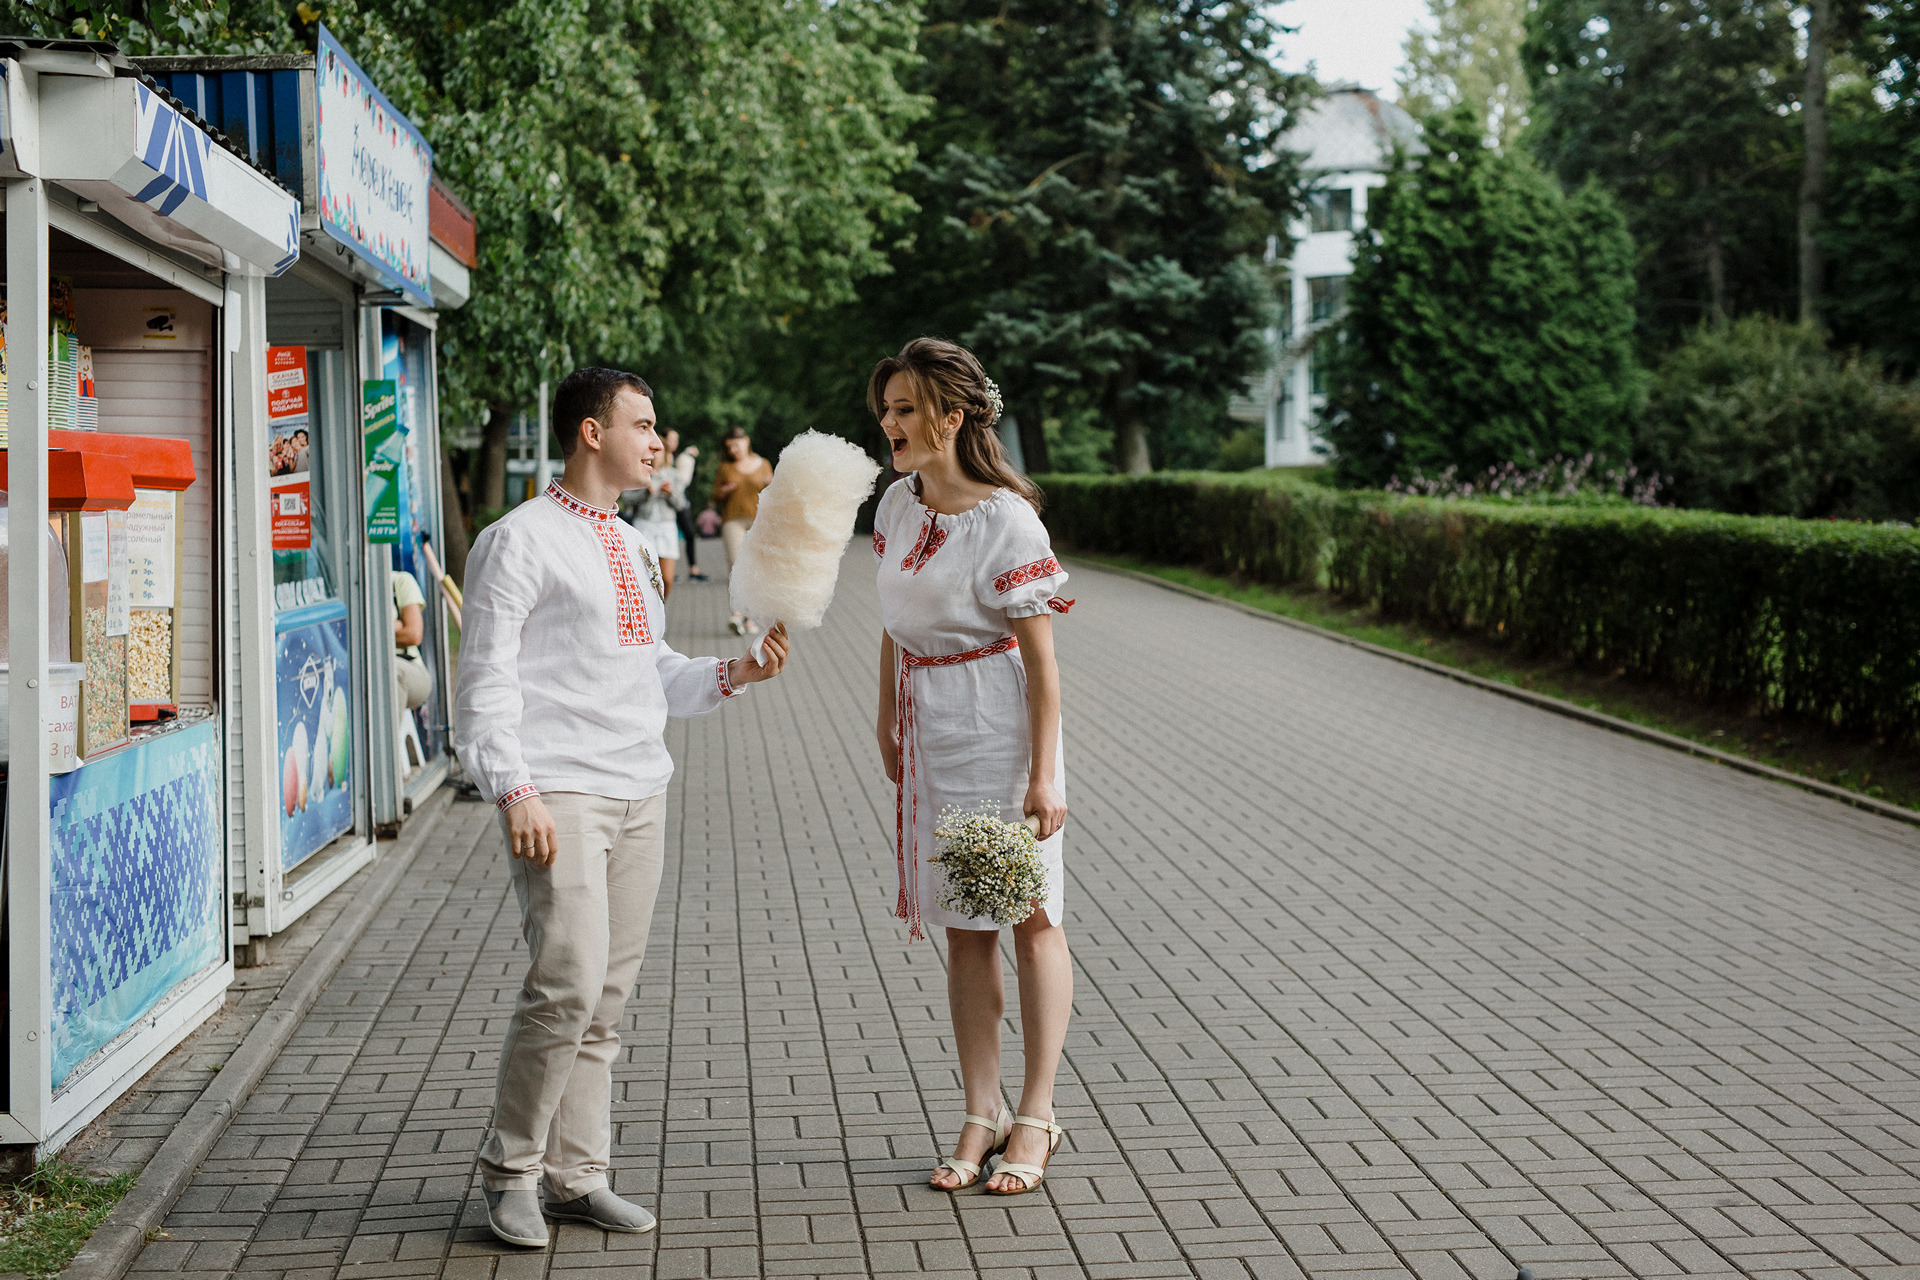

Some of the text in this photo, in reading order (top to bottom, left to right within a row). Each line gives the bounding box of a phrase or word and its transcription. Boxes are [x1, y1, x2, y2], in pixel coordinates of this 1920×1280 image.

[271, 395, 303, 406] ПОЛУЧАЙ
[272, 402, 304, 413] ПОДАРКИ
[363, 395, 395, 420] Sprite
[126, 512, 173, 521] рамельный
[368, 527, 398, 535] МЯТЫ
[144, 578, 155, 588] 4р.
[50, 742, 77, 758] 3 ру
